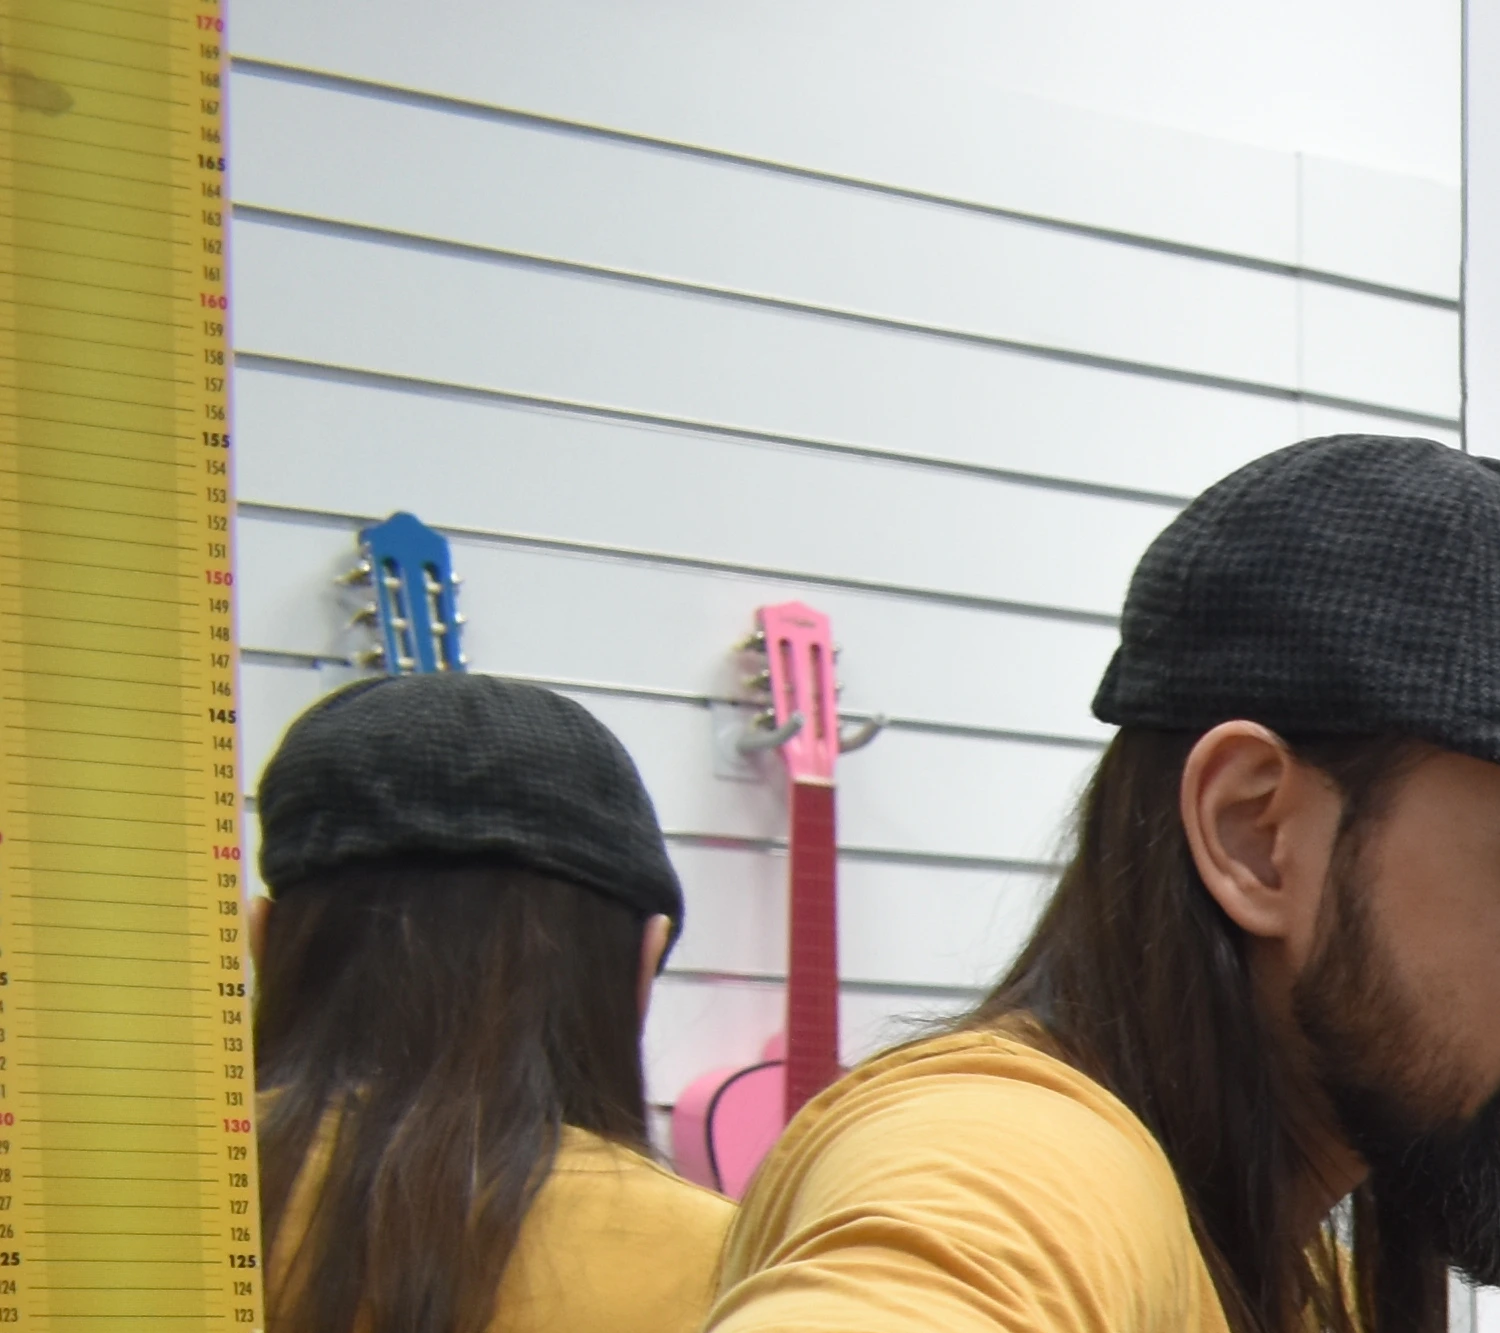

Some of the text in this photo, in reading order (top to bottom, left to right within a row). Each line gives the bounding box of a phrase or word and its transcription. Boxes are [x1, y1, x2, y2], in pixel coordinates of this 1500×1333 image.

[196, 14, 225, 34] 170
[199, 42, 221, 60] 169
[199, 70, 222, 89] 168
[200, 98, 221, 116] 167
[200, 126, 222, 145] 166
[197, 153, 227, 173] 165
[201, 181, 223, 199] 164
[201, 209, 223, 228] 163
[201, 237, 224, 256] 162
[202, 264, 222, 282] 161
[199, 292, 229, 311] 160
[203, 320, 225, 338] 159
[203, 348, 225, 367] 158
[204, 376, 226, 393] 157
[204, 403, 226, 422] 156
[202, 431, 231, 449] 155
[205, 458, 227, 476] 154
[206, 486, 228, 505] 153
[206, 514, 229, 533] 152
[207, 542, 227, 560] 151
[205, 569, 234, 587] 150
[208, 597, 231, 614] 149
[209, 625, 231, 643] 148
[210, 652, 231, 669] 147
[211, 680, 233, 698] 146
[208, 707, 237, 725] 145
[212, 735, 234, 752] 144
[213, 763, 235, 780] 143
[214, 790, 235, 807] 142
[215, 817, 234, 834] 141
[212, 845, 242, 861] 140
[216, 872, 238, 889] 139
[217, 900, 239, 917] 138
[218, 927, 239, 943] 137
[219, 954, 241, 971] 136
[217, 982, 246, 998] 135
[222, 1009, 242, 1025] 134
[223, 1037, 243, 1052] 133
[224, 1064, 244, 1080] 132
[225, 1091, 244, 1107] 131
[222, 1118, 252, 1134] 130
[227, 1145, 248, 1161] 129
[228, 1172, 249, 1188] 128
[230, 1200, 249, 1215] 127
[231, 1227, 251, 1242] 126
[228, 1254, 257, 1269] 125
[233, 1281, 253, 1296] 124
[234, 1308, 255, 1323] 123
